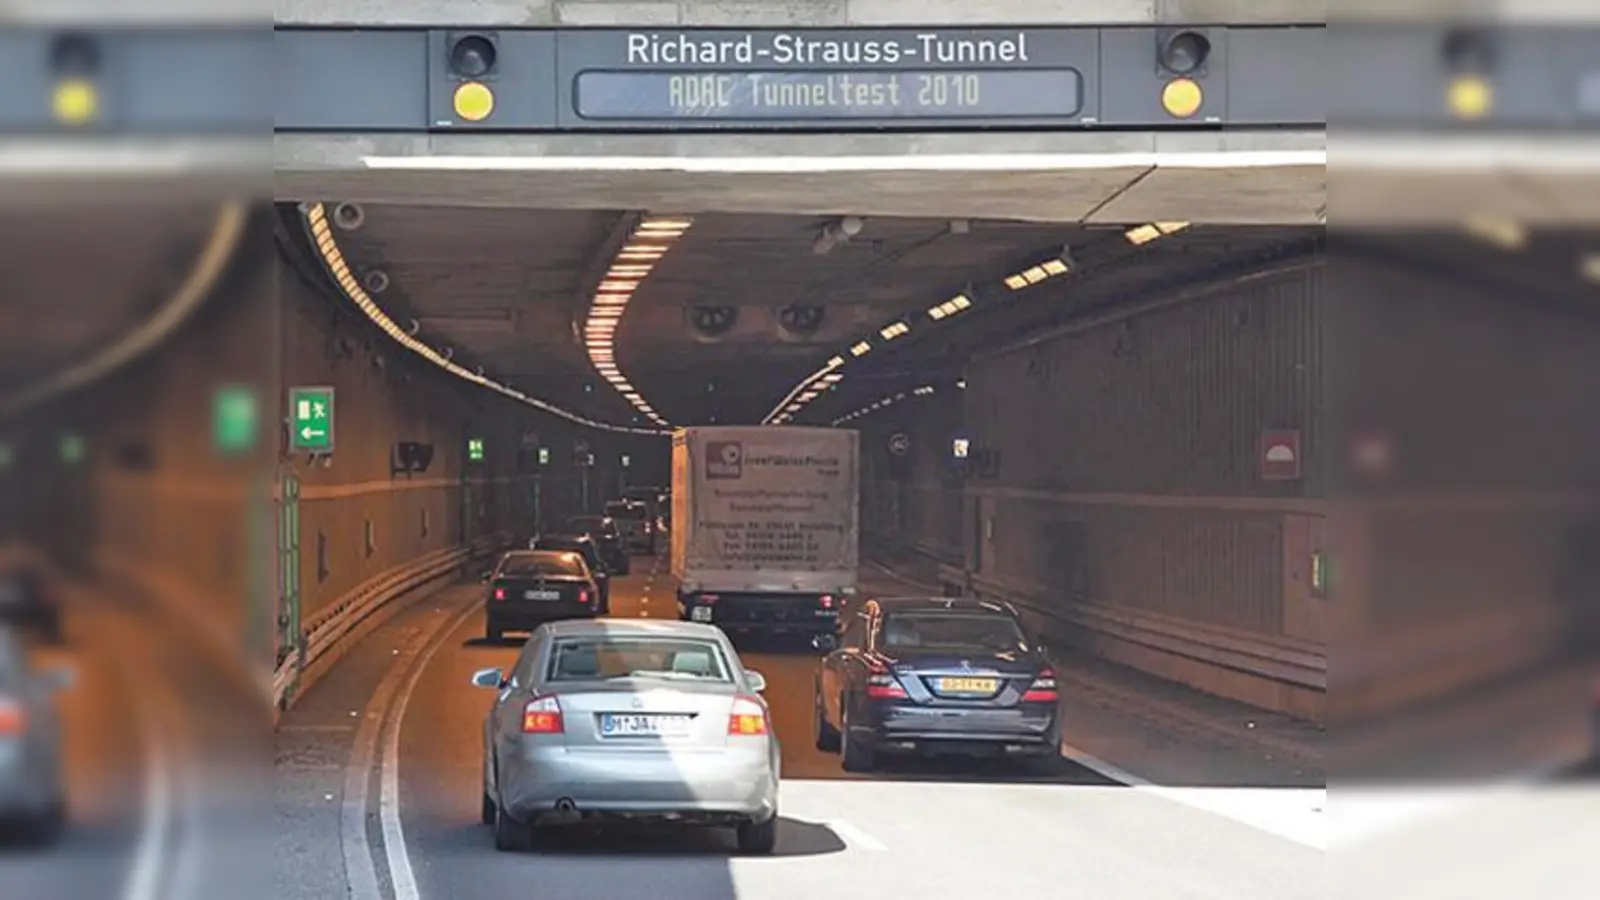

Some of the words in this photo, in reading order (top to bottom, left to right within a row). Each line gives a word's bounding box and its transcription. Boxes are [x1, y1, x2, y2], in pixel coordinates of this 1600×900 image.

[627, 33, 1028, 63] Richard-Strauss-Tunnel
[669, 74, 730, 107] ADAC
[749, 74, 900, 106] Tunneltest
[919, 74, 980, 106] 2010
